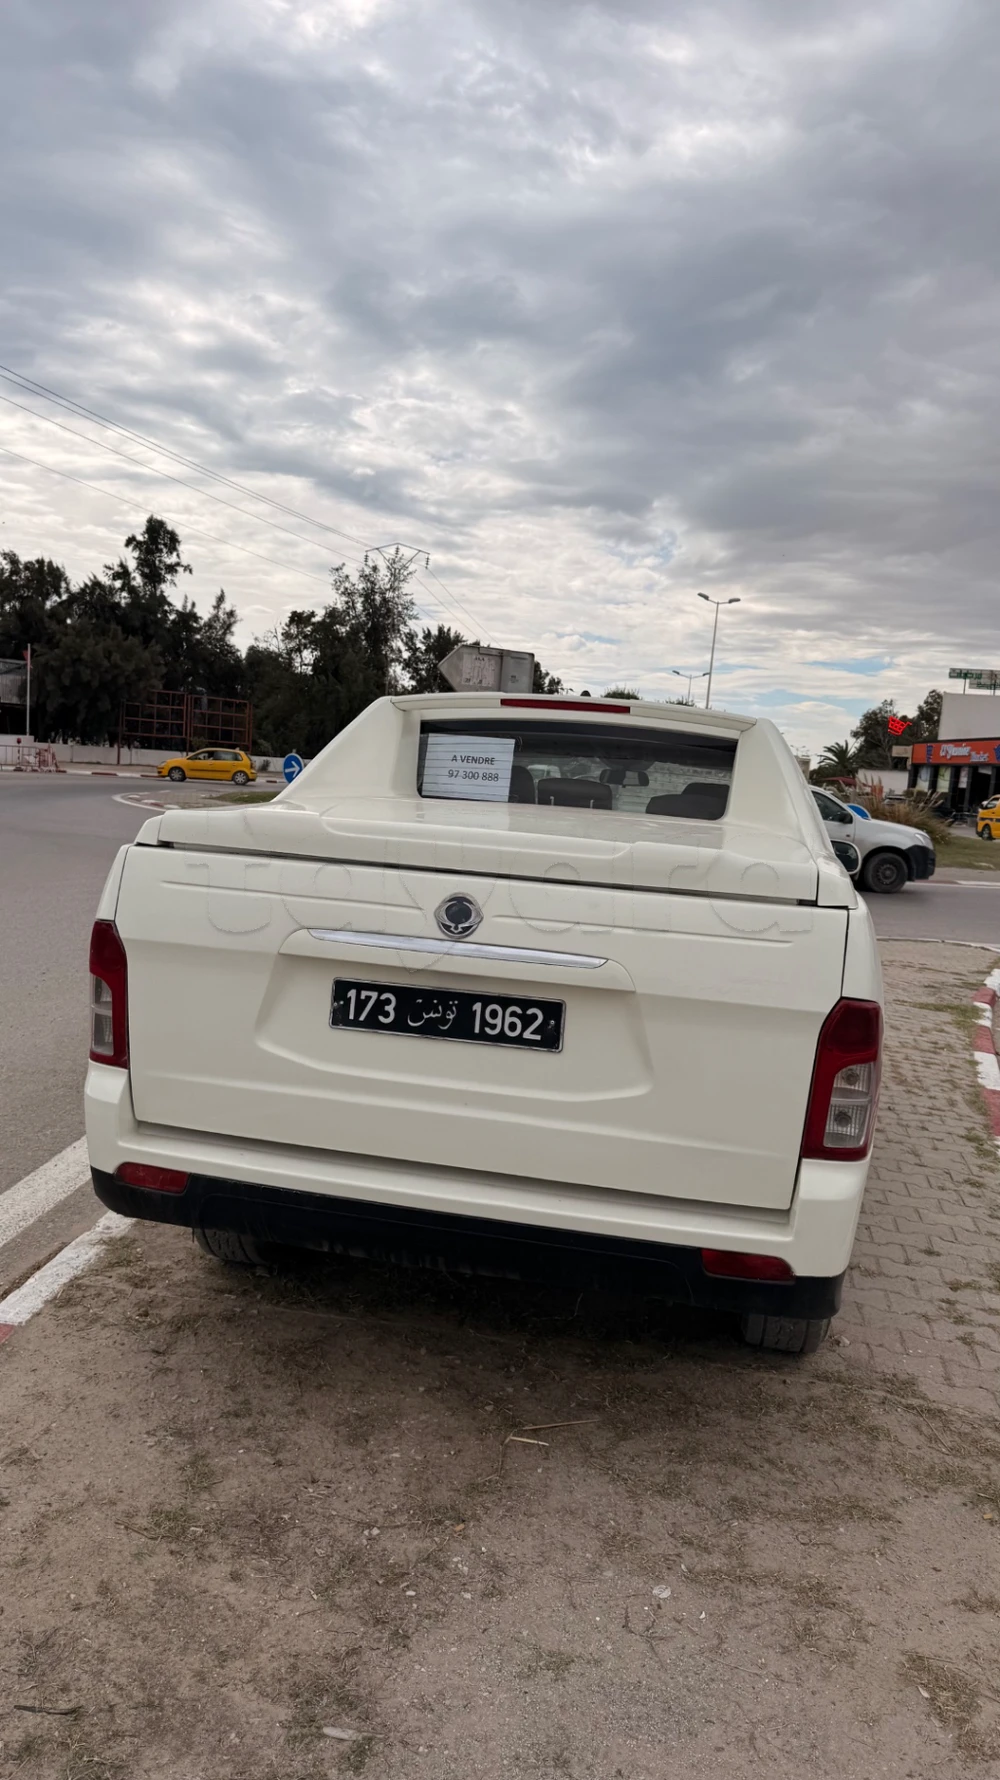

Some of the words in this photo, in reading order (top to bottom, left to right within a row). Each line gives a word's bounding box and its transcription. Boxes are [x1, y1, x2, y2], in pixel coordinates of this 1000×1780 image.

[451, 754, 458, 763] A
[460, 754, 496, 765] VENDRE
[448, 769, 460, 778] 97
[461, 771, 480, 780] 300
[481, 772, 500, 782] 888
[346, 988, 397, 1024] 173
[407, 999, 459, 1030] تونس
[472, 1001, 544, 1041] 1962
